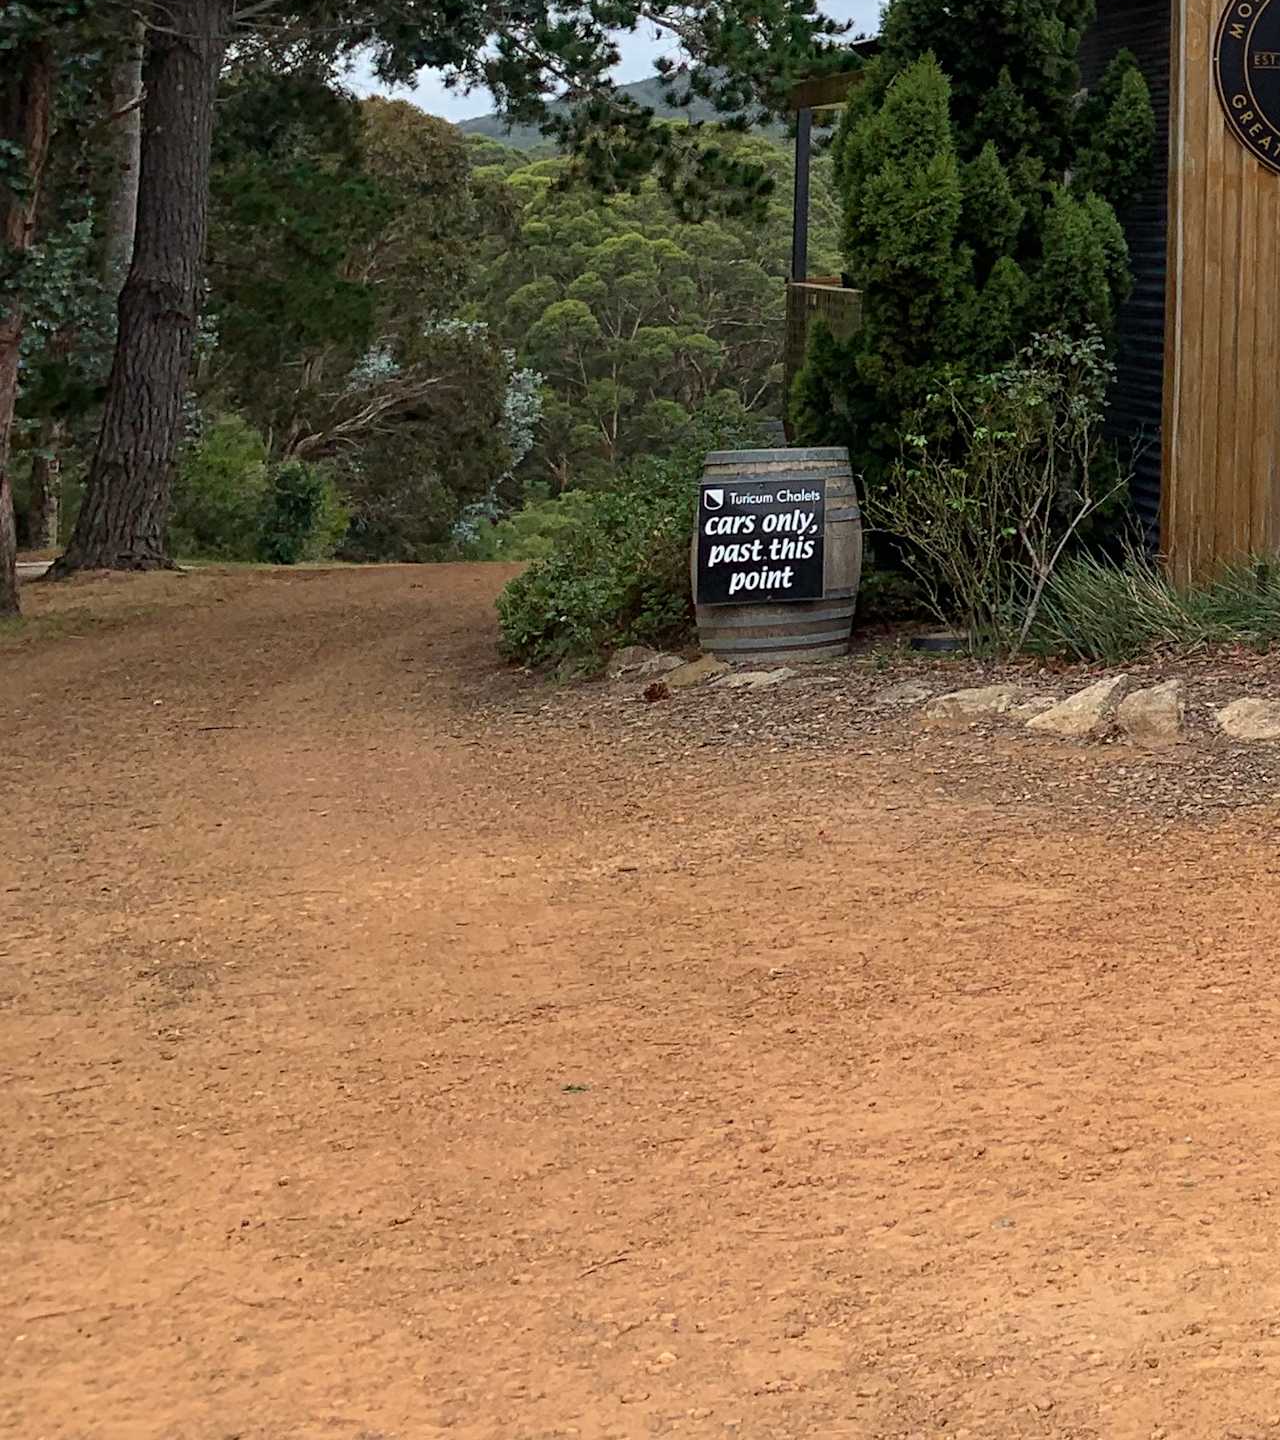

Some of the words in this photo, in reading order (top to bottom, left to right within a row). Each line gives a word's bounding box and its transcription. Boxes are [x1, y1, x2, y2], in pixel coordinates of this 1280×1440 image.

[729, 491, 774, 505] Turicum
[776, 489, 821, 503] Chalets
[705, 513, 756, 536] cars
[762, 509, 818, 535] only,
[708, 539, 764, 567] past
[769, 536, 815, 561] this
[728, 566, 794, 595] point
